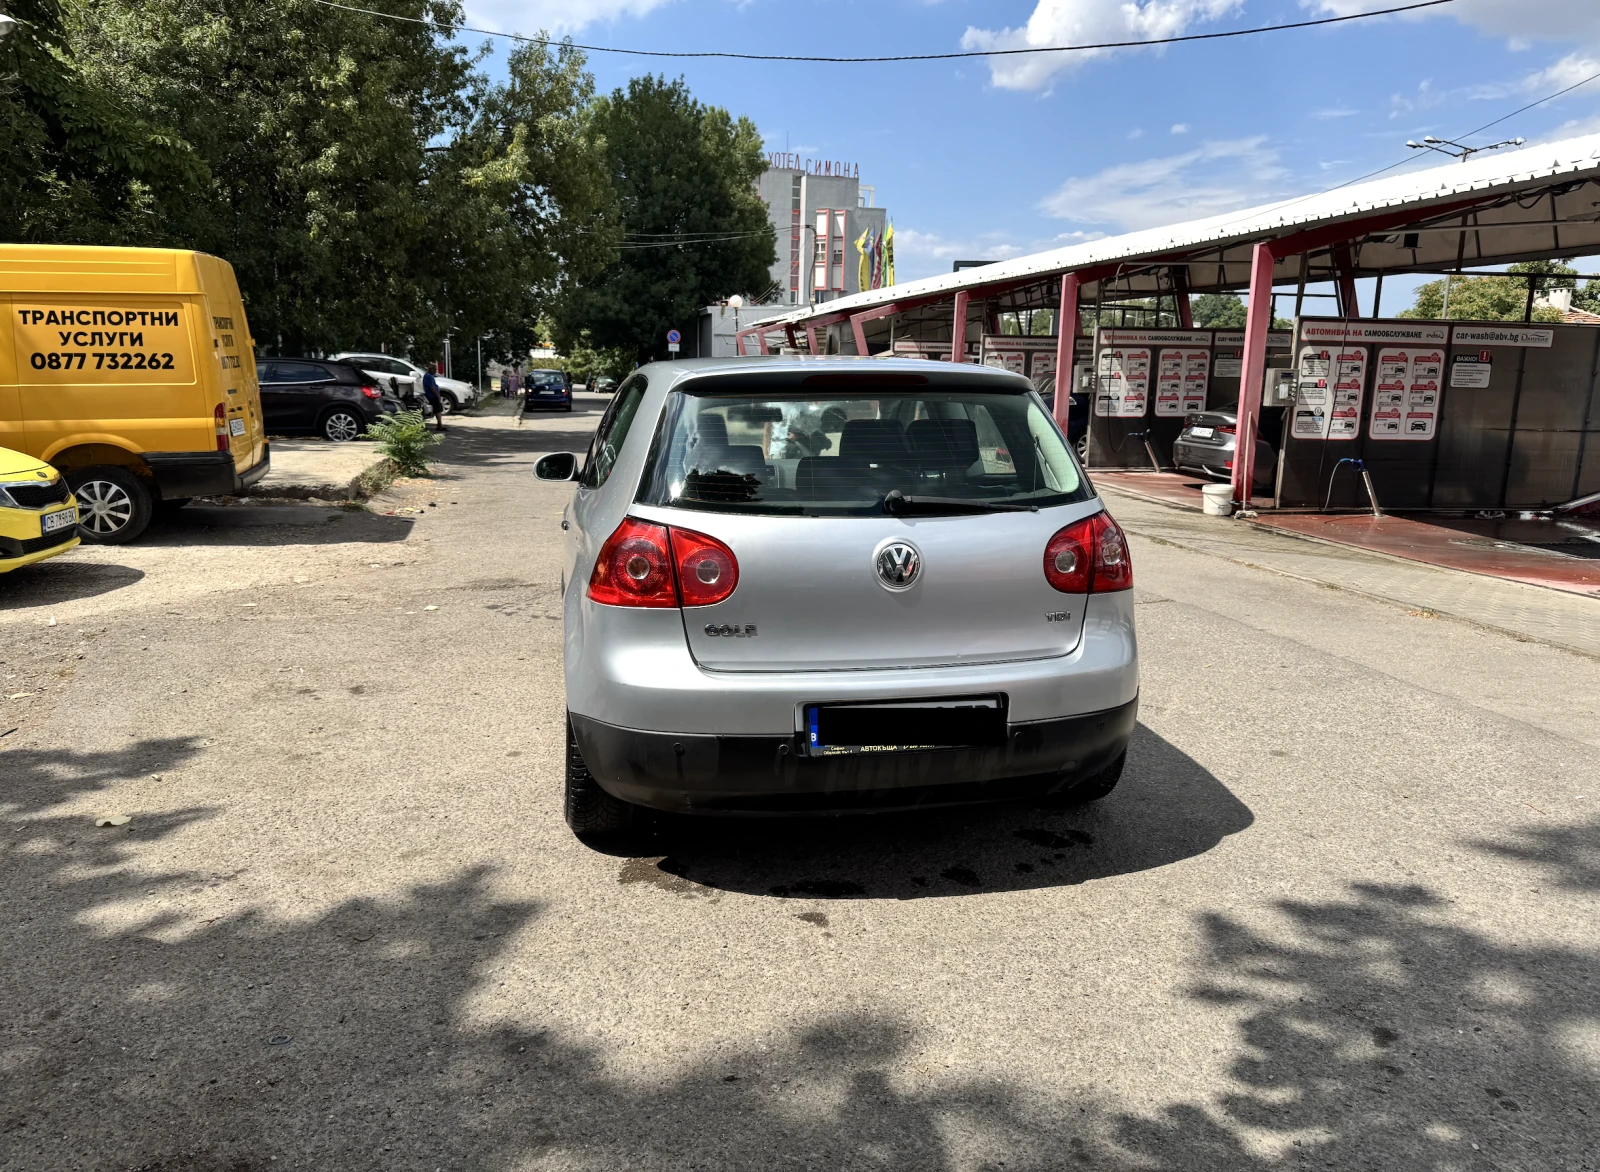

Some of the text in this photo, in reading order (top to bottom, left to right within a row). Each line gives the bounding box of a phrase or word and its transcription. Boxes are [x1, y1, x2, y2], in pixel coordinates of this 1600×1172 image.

[768, 152, 859, 179] ХОТЕЛ СИМОНА
[18, 310, 179, 327] ТРАНСПОРТНИ
[58, 332, 144, 347] УСЛУГИ
[1306, 328, 1422, 339] АВТОМИВКА НА САМООБСЛУЖВАНЕ
[1455, 332, 1519, 342] car-wash@abv.bg
[30, 352, 175, 370] 0877 732262
[704, 623, 757, 637] GOLF
